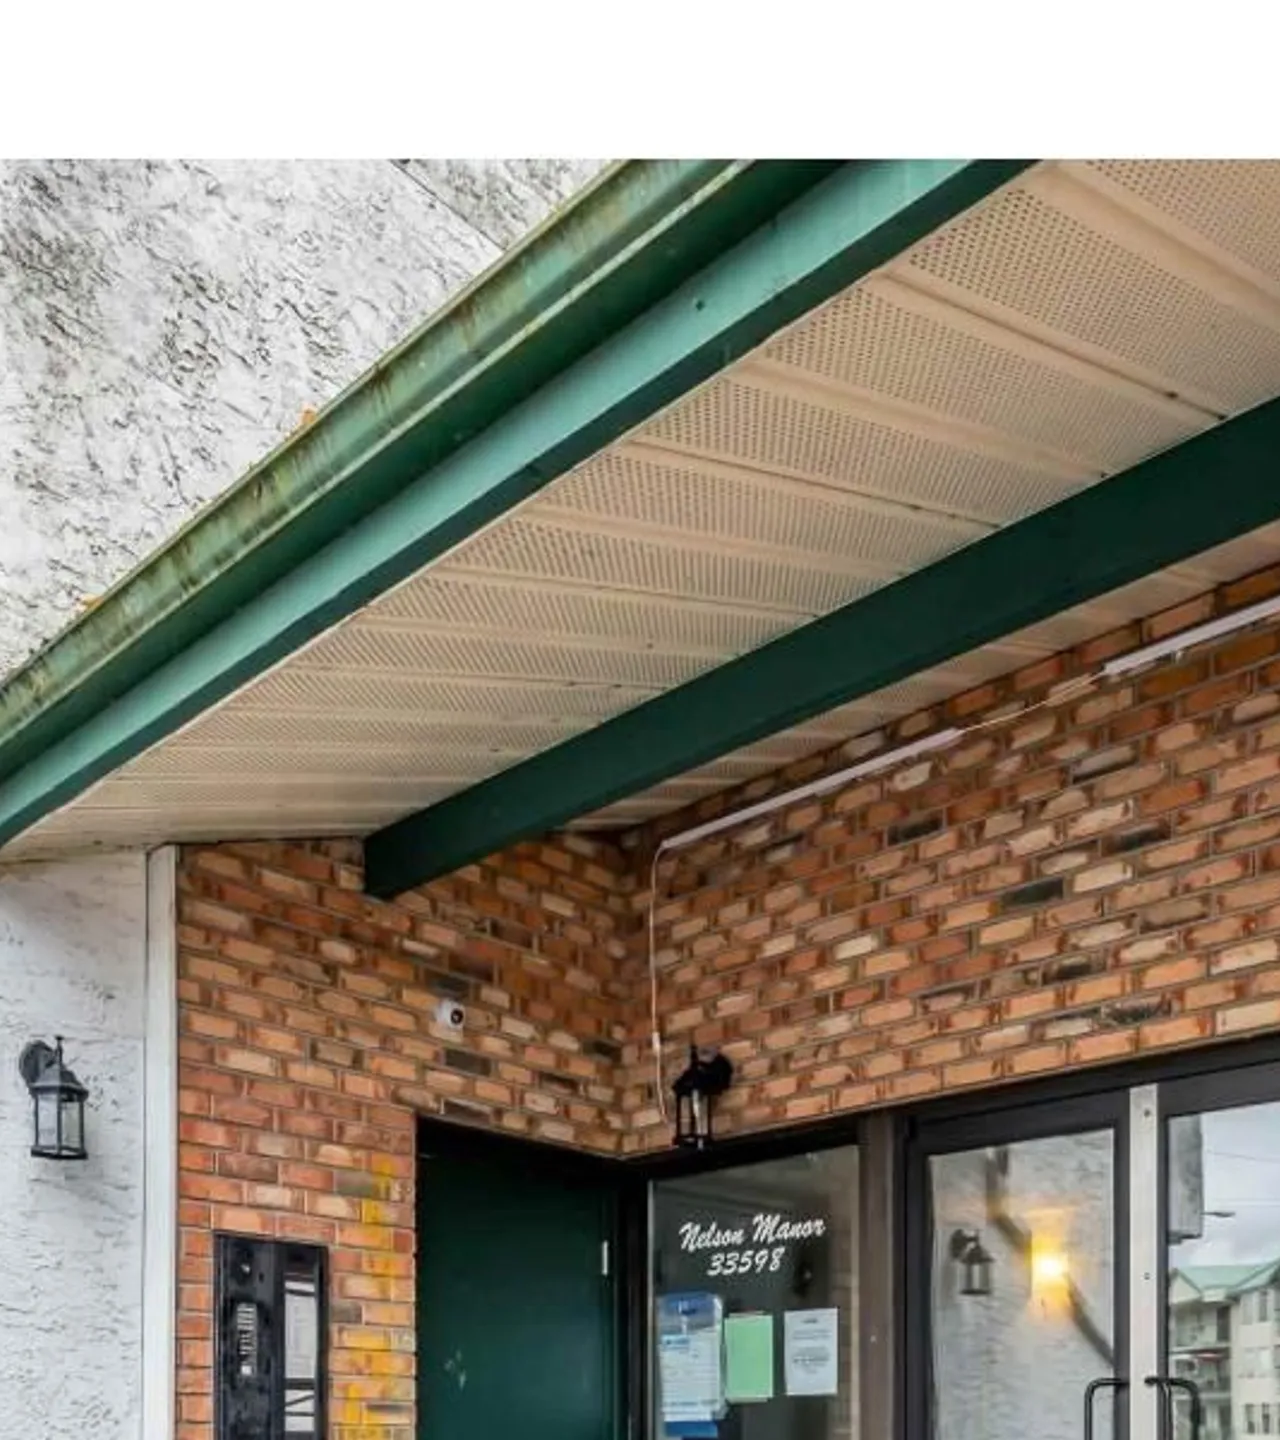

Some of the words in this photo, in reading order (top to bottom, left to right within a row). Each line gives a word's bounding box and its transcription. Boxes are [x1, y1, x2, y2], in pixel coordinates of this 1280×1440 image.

[678, 1221, 746, 1253] Nelson
[752, 1212, 827, 1245] Manor
[706, 1247, 786, 1276] 33598
